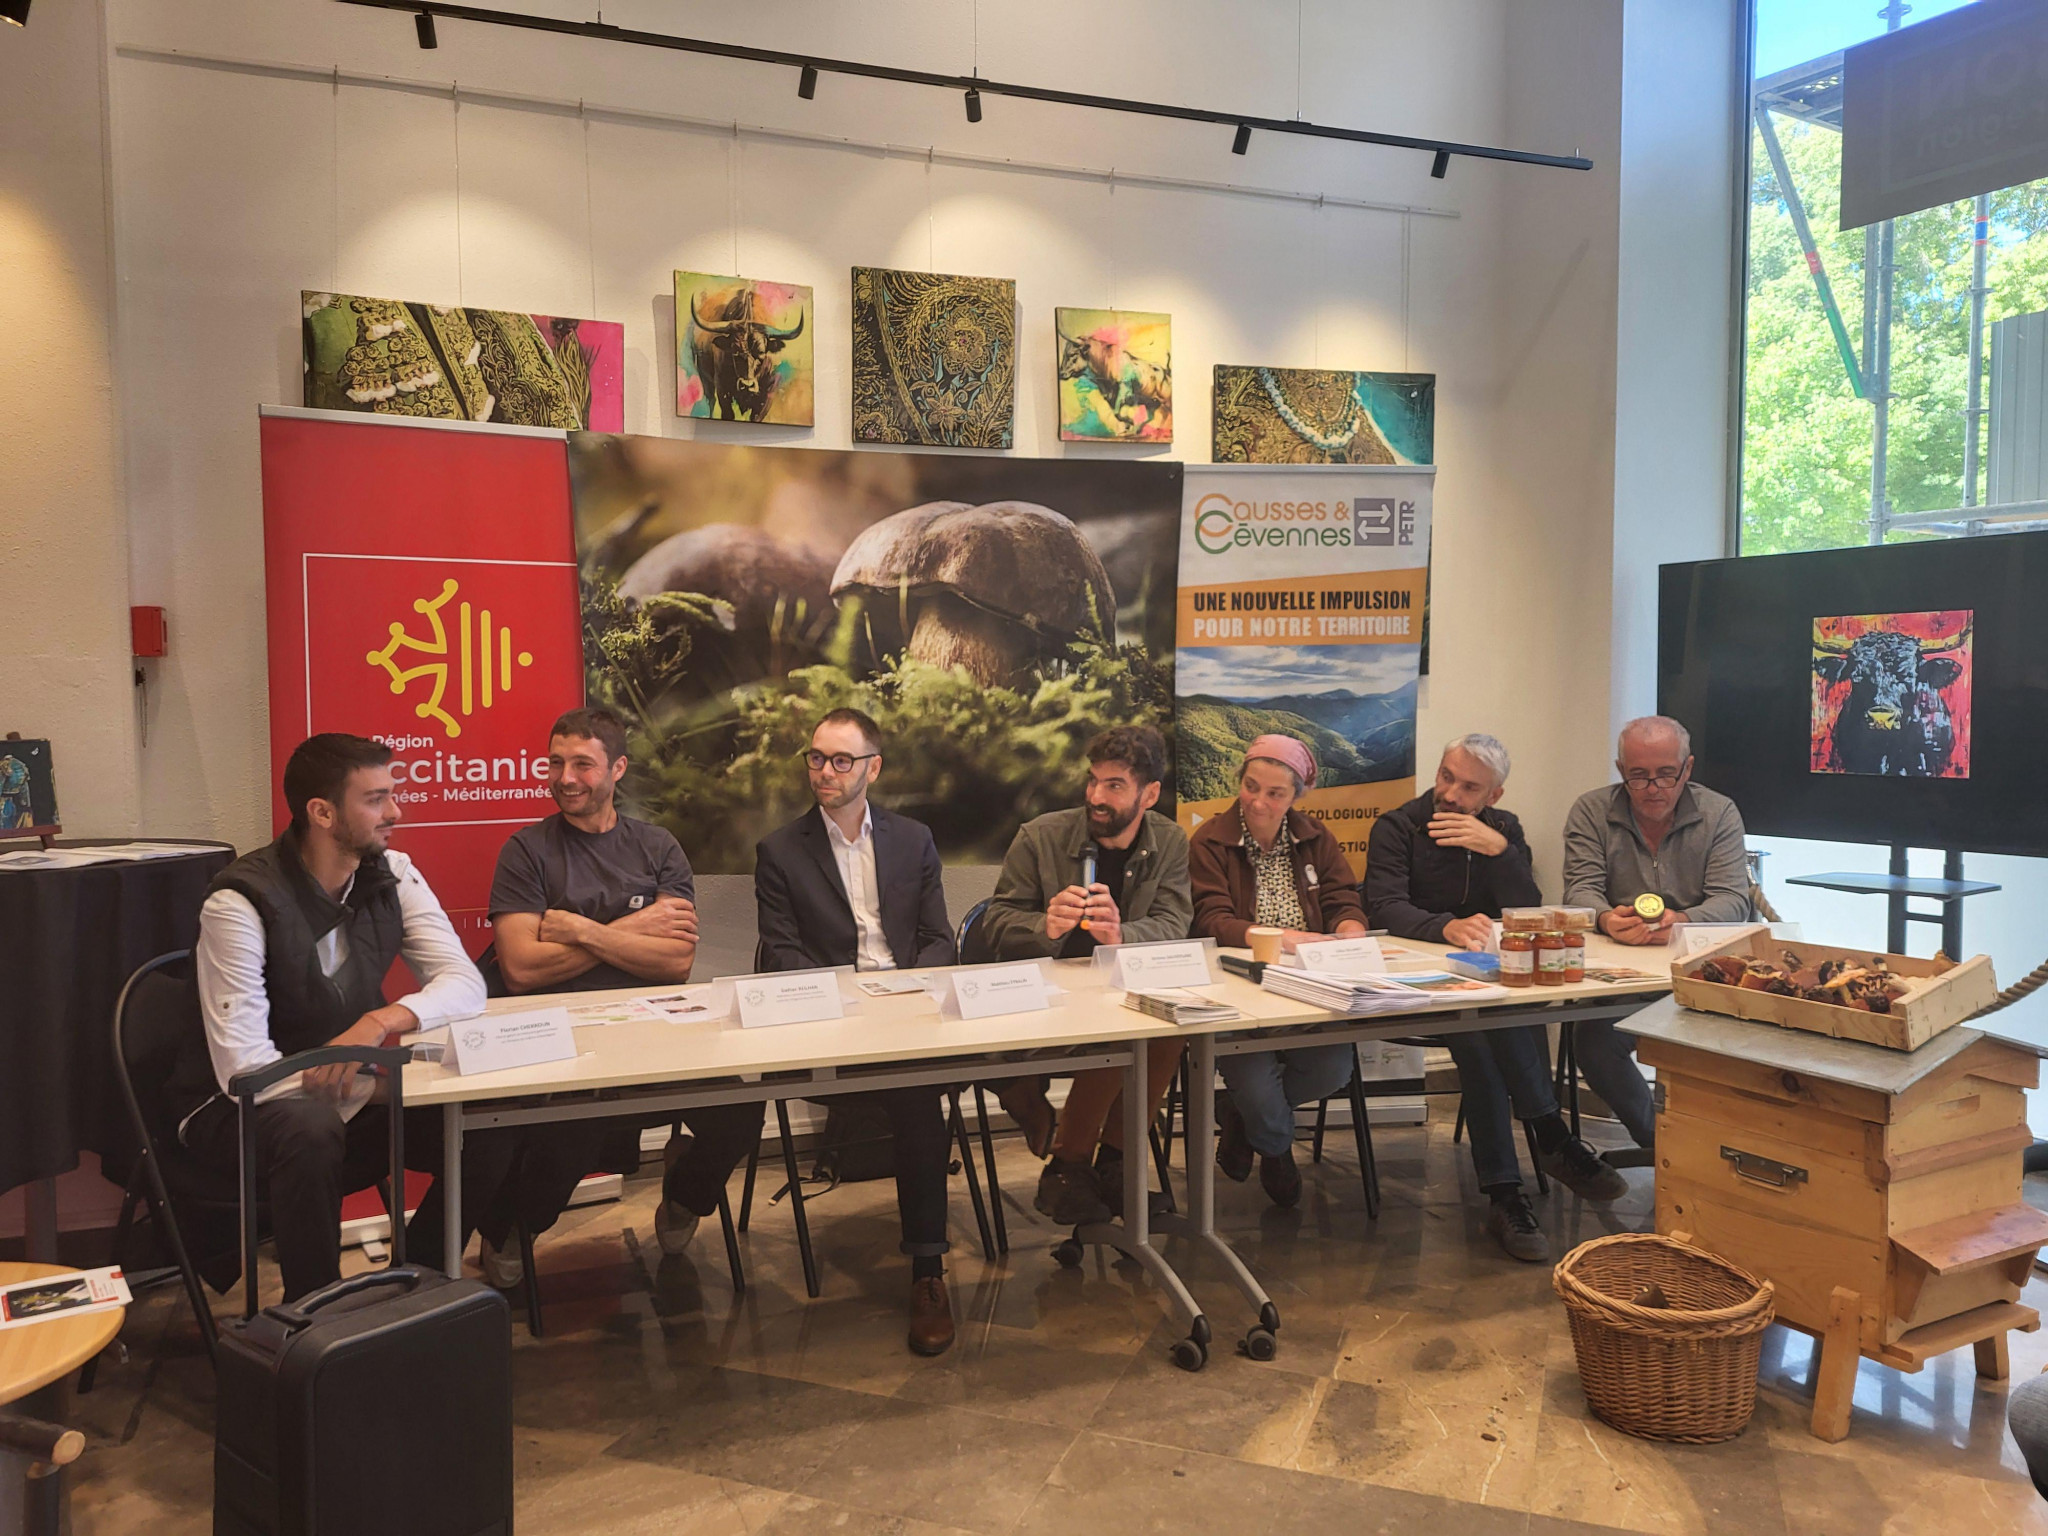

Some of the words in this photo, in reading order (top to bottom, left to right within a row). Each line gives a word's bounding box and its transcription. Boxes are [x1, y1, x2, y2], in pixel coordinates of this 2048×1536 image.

[1194, 493, 1328, 537] Causses
[1333, 500, 1351, 522] &
[1398, 500, 1416, 546] PETR
[1193, 592, 1227, 612] UNE
[1231, 591, 1316, 611] NOUVELLE
[1320, 590, 1411, 610] IMPULSION
[1193, 618, 1244, 639] POUR
[1250, 617, 1312, 637] NOTRE
[1317, 615, 1411, 636] TERRITOIRE
[386, 748, 550, 785] ccitanie
[391, 789, 429, 804] nées
[1338, 841, 1367, 853] STIQ
